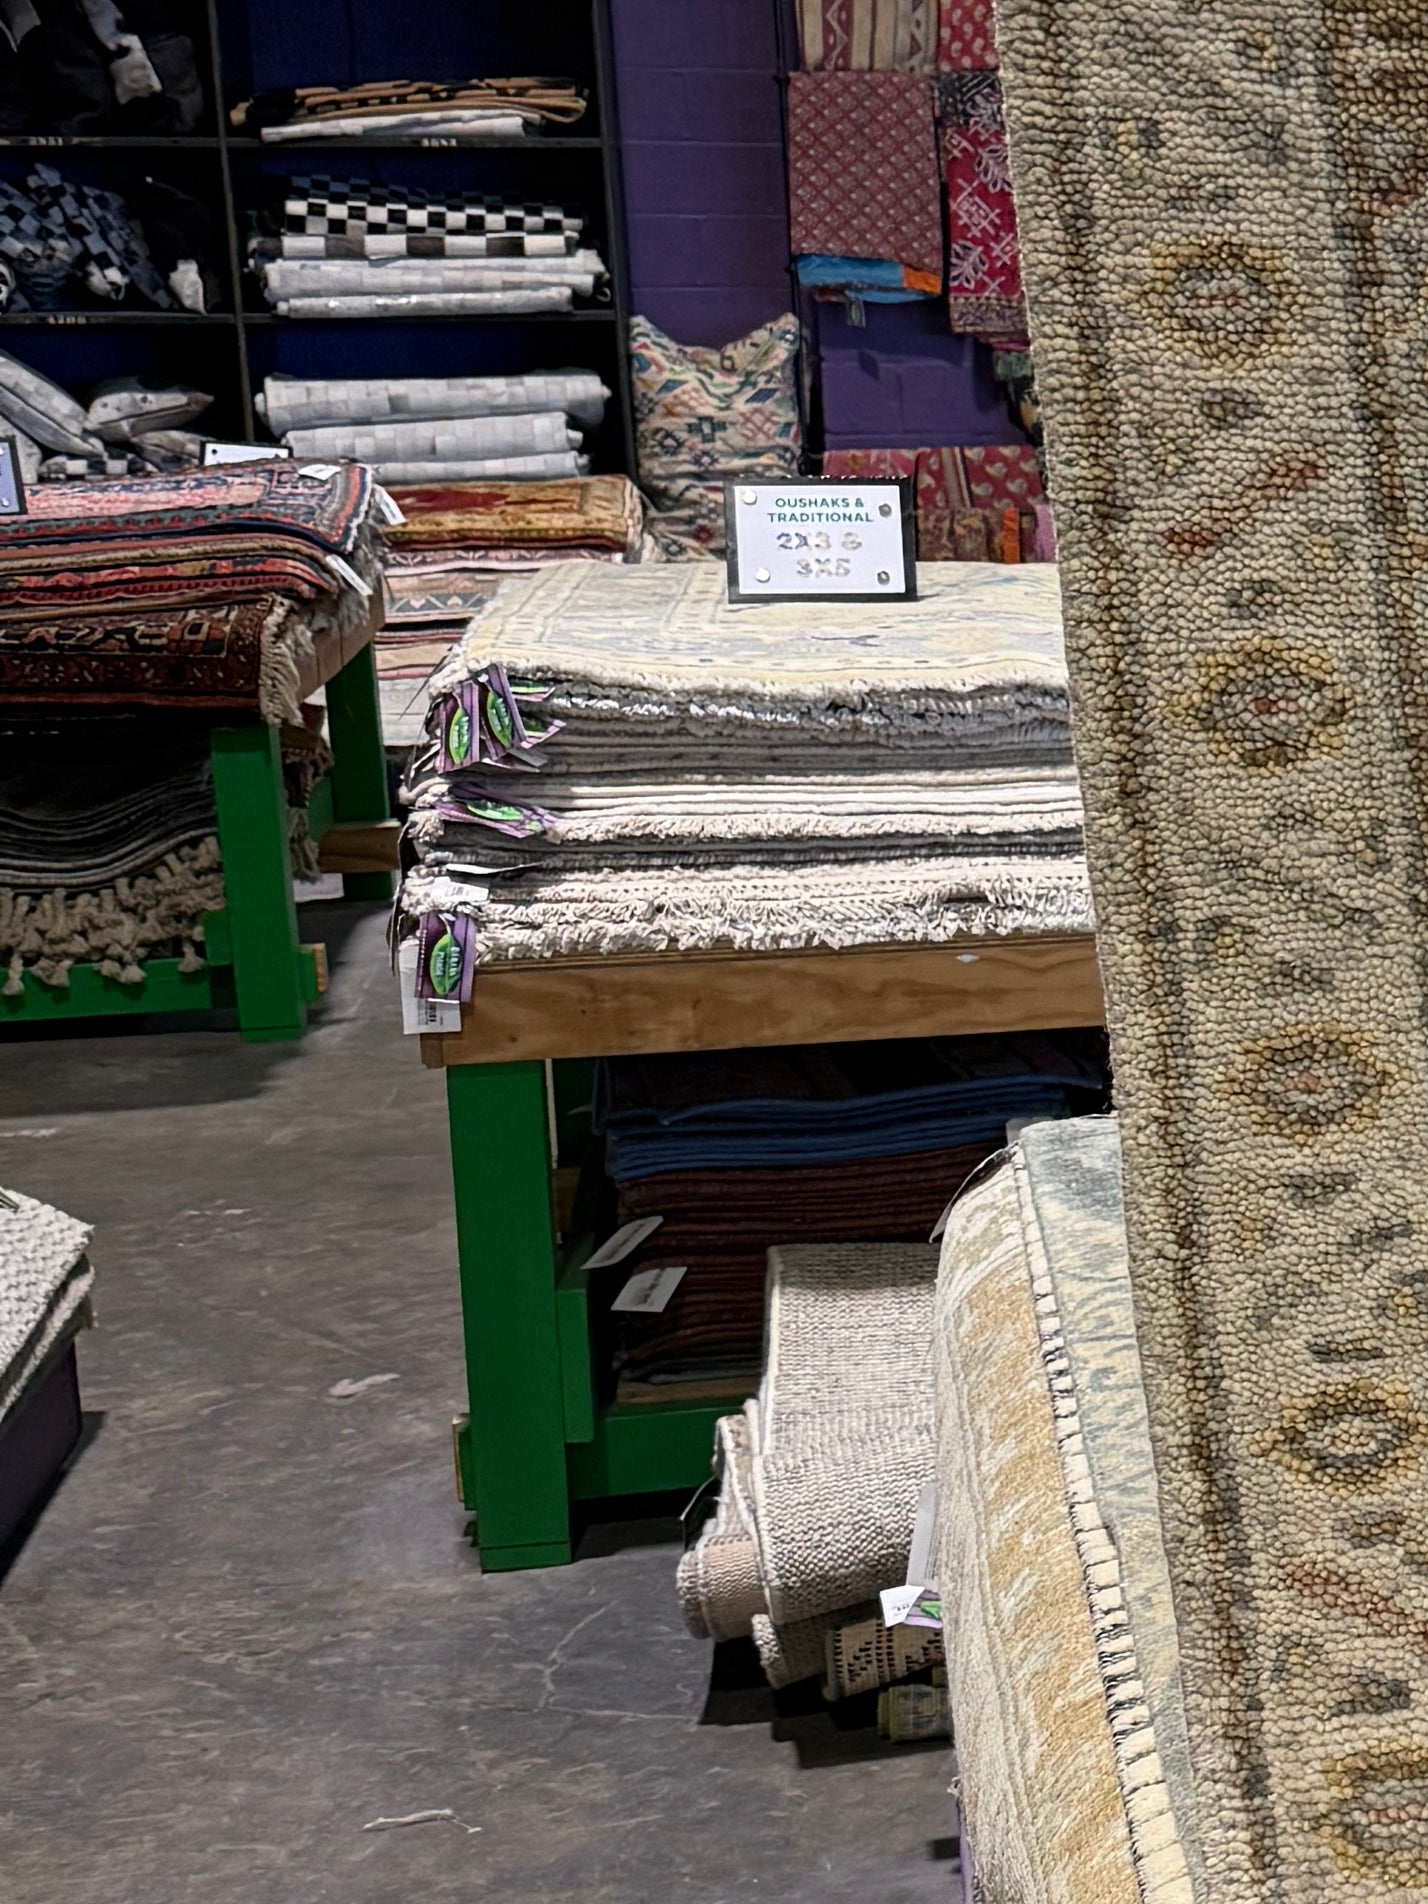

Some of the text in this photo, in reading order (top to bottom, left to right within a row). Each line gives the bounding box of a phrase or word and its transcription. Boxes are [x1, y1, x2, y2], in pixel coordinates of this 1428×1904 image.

[775, 497, 864, 508] OUSHAKS &
[767, 512, 874, 523] TRADITIONAL
